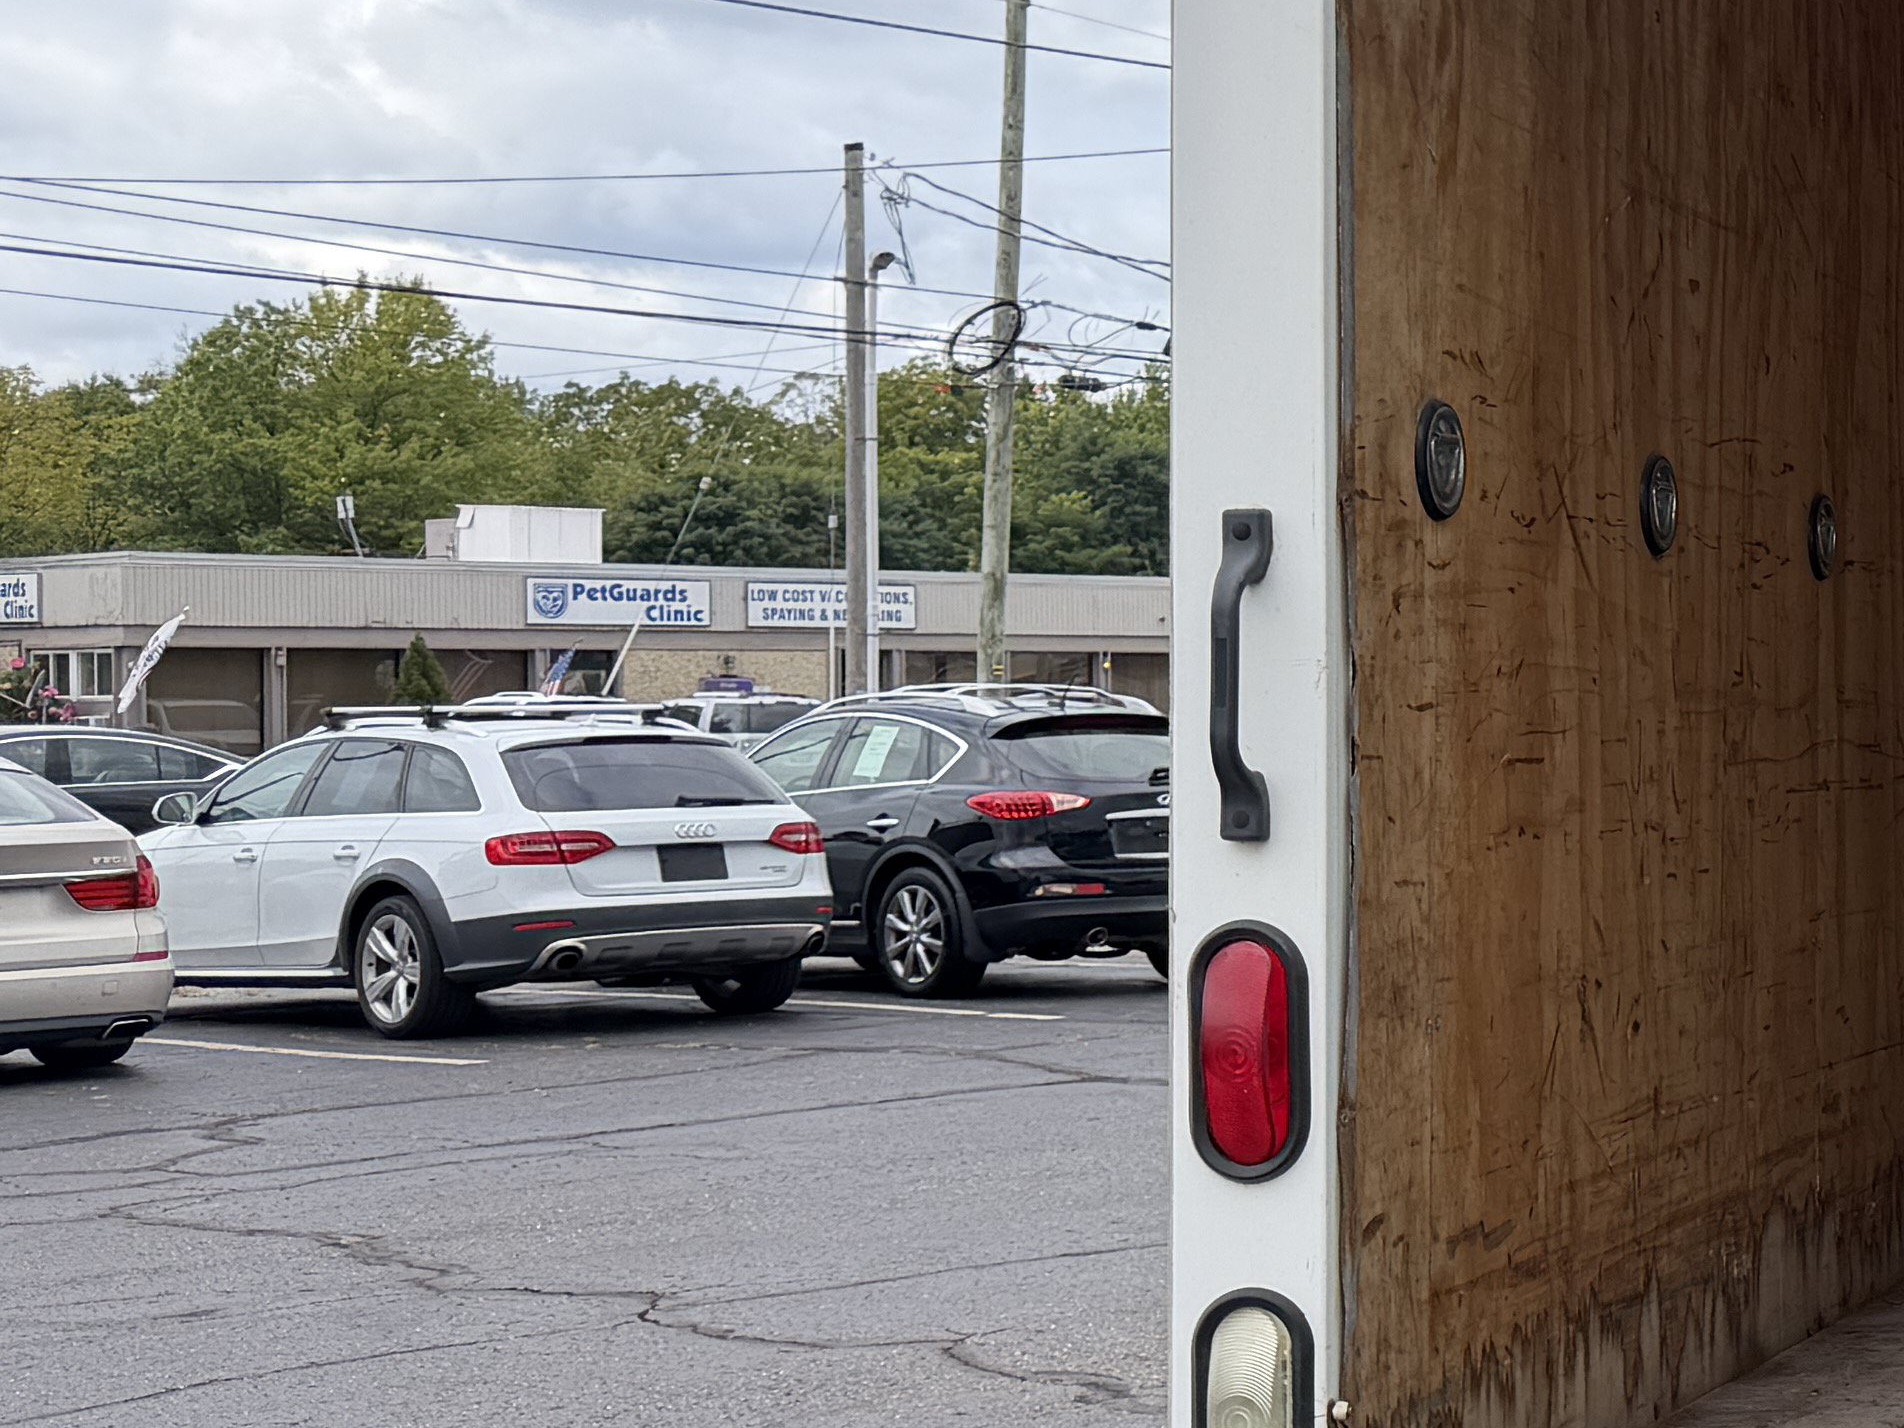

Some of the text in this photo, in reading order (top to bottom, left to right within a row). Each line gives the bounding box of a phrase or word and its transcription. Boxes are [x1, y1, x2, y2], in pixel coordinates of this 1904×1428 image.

[572, 583, 688, 603] PetGuards
[750, 589, 778, 602] LOW
[783, 589, 815, 603] COST
[4, 600, 35, 619] Clinic
[645, 605, 704, 622] Clinic
[762, 608, 815, 621] SPAYING
[819, 609, 828, 621] &
